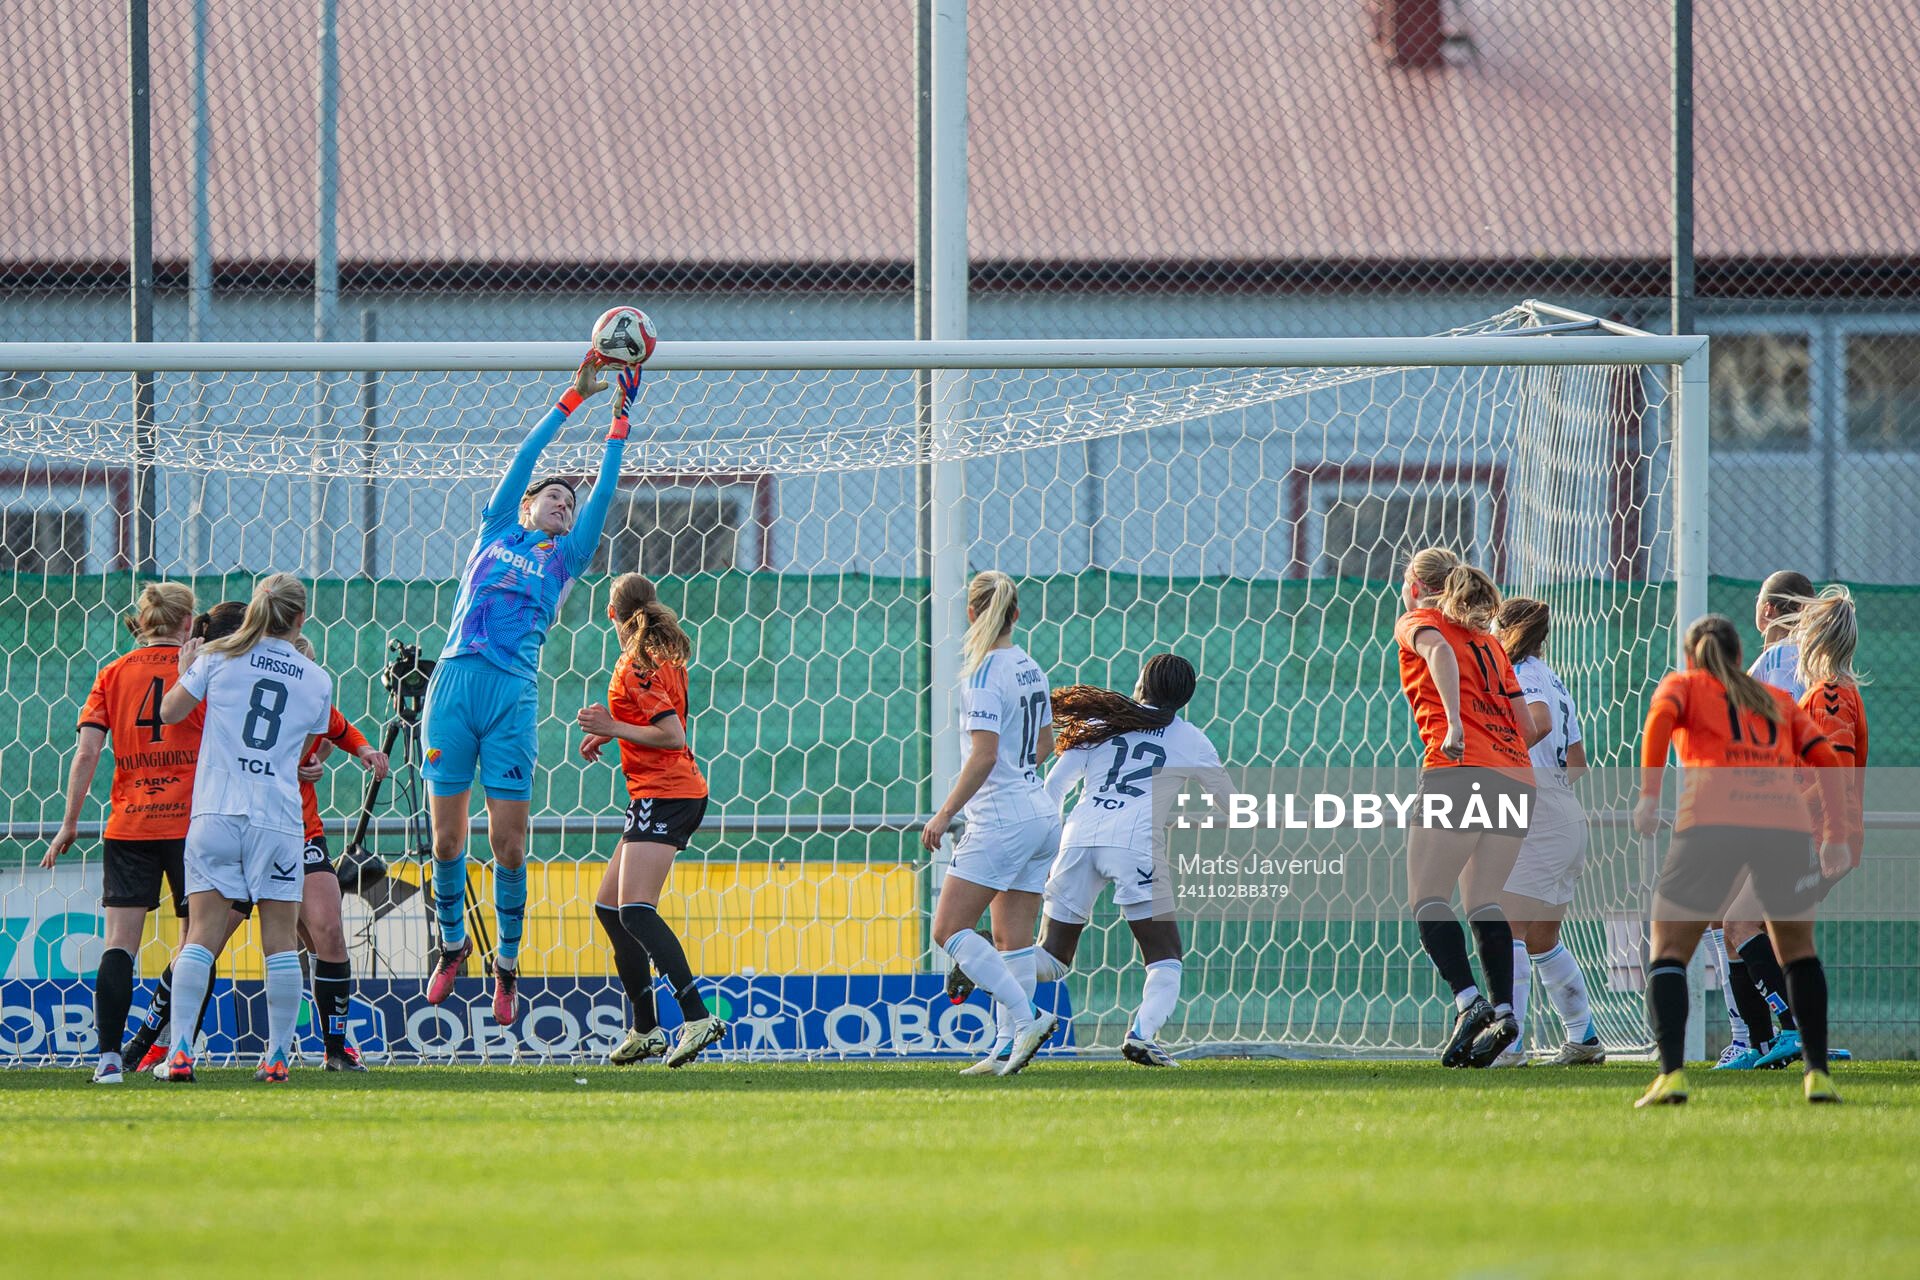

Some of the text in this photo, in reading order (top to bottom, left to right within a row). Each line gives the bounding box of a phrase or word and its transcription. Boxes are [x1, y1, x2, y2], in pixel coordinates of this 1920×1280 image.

[488, 545, 544, 578] MOBILL
[250, 654, 304, 680] LARSSON
[1466, 640, 1508, 697] 11
[135, 675, 166, 743] 4
[241, 678, 289, 751] 8
[967, 710, 998, 721] sadium
[1019, 691, 1047, 768] 10
[135, 776, 181, 788] SARKA
[238, 758, 275, 777] TCL
[1099, 736, 1167, 798] 12
[407, 1004, 629, 1055] OBOS
